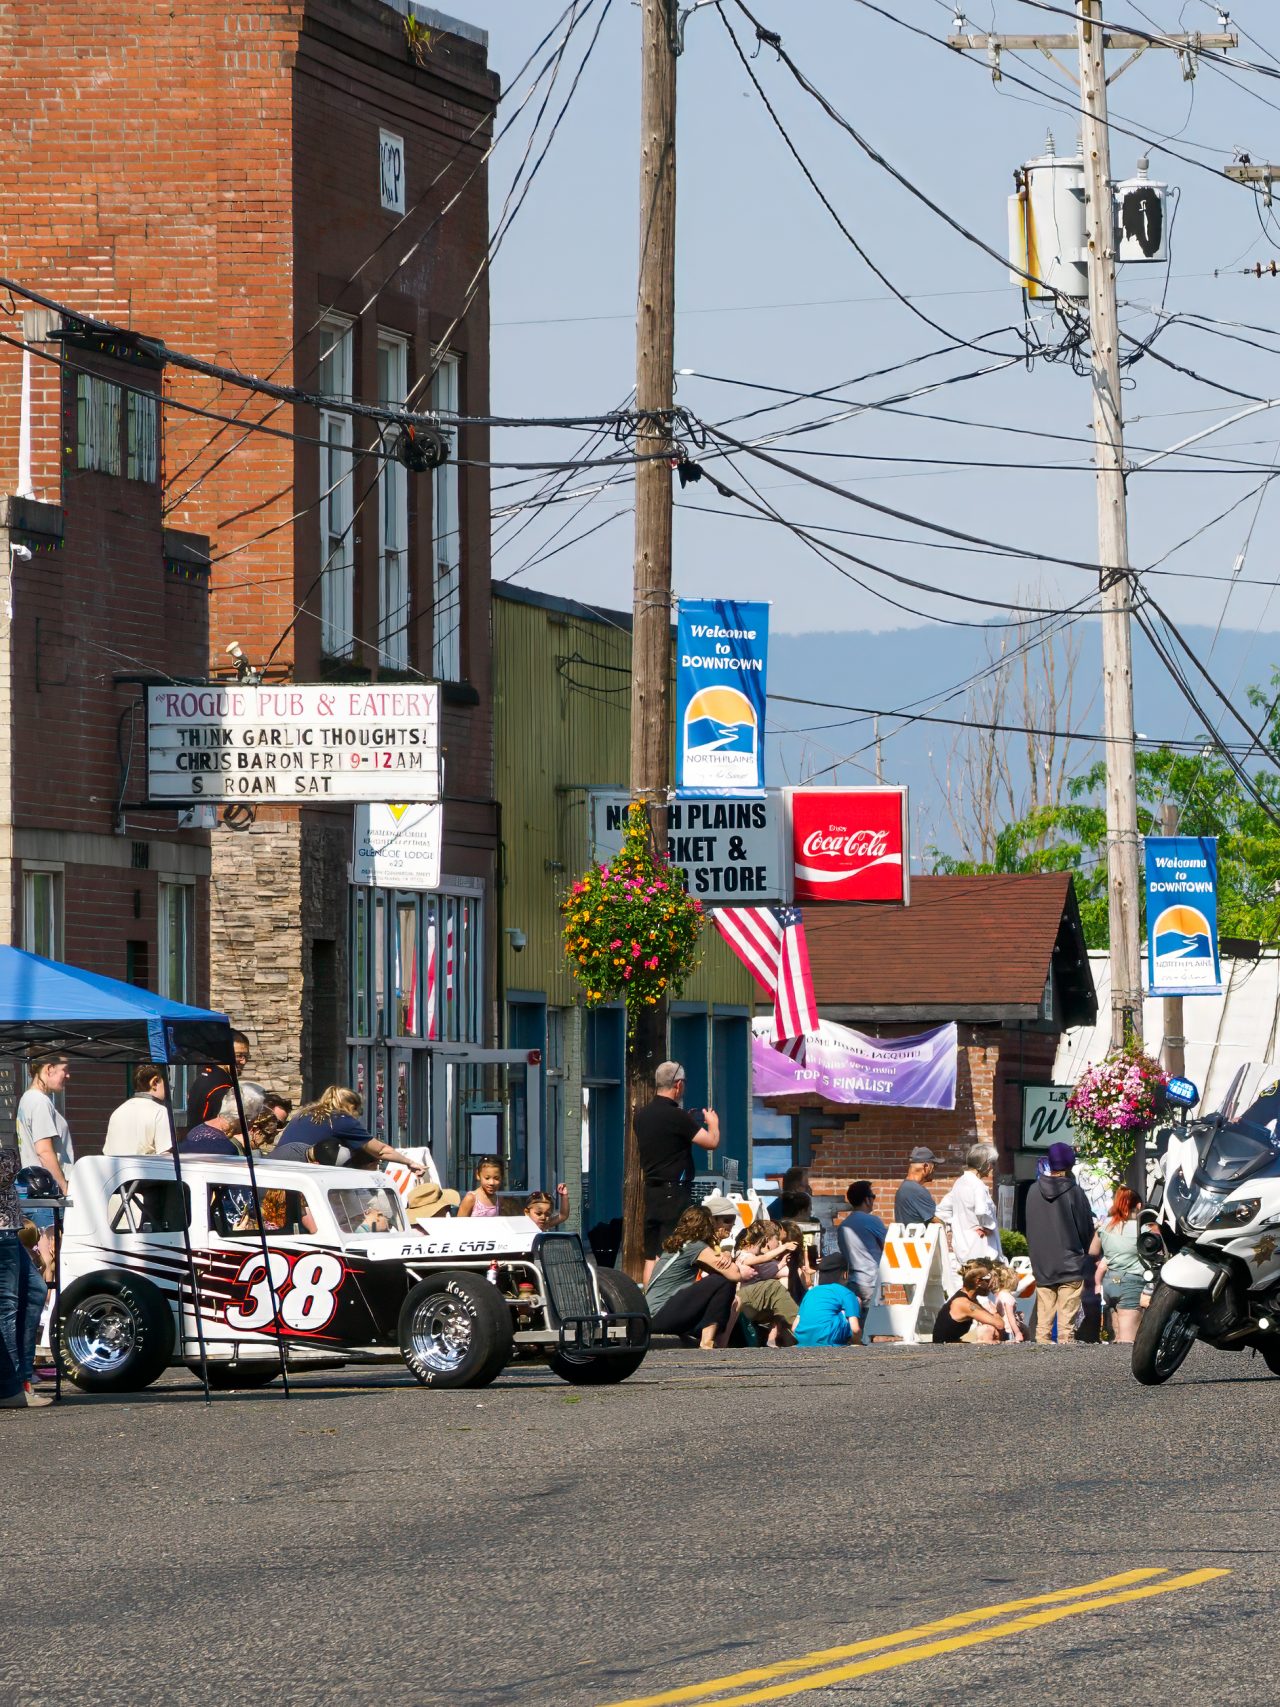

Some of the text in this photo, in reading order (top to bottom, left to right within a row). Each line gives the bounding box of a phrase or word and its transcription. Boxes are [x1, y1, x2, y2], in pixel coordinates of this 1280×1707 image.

[690, 624, 757, 640] Welcome
[715, 642, 731, 655] to
[682, 655, 763, 672] DOWNTOWN
[166, 692, 435, 717] ROGUE PUB & EATERY
[176, 728, 427, 747] THINK GARLIC THOUGHTS!
[176, 752, 232, 771] CHRIS
[237, 752, 304, 770] BARON
[310, 752, 342, 770] FRI
[686, 754, 721, 764] NORTH
[224, 775, 277, 794] ROAN
[294, 775, 332, 793] SAT
[687, 803, 767, 830] PLAINS
[728, 835, 748, 861] &
[802, 829, 891, 858] Coca-Cola
[1155, 856, 1208, 869] Welcome
[695, 865, 767, 893] STORE
[1175, 870, 1188, 881] to
[1150, 881, 1214, 893] DOWNTOWN
[794, 1069, 894, 1094] TOP 5 FINALIST
[458, 1240, 497, 1252] CARS
[224, 1250, 345, 1333] 38
